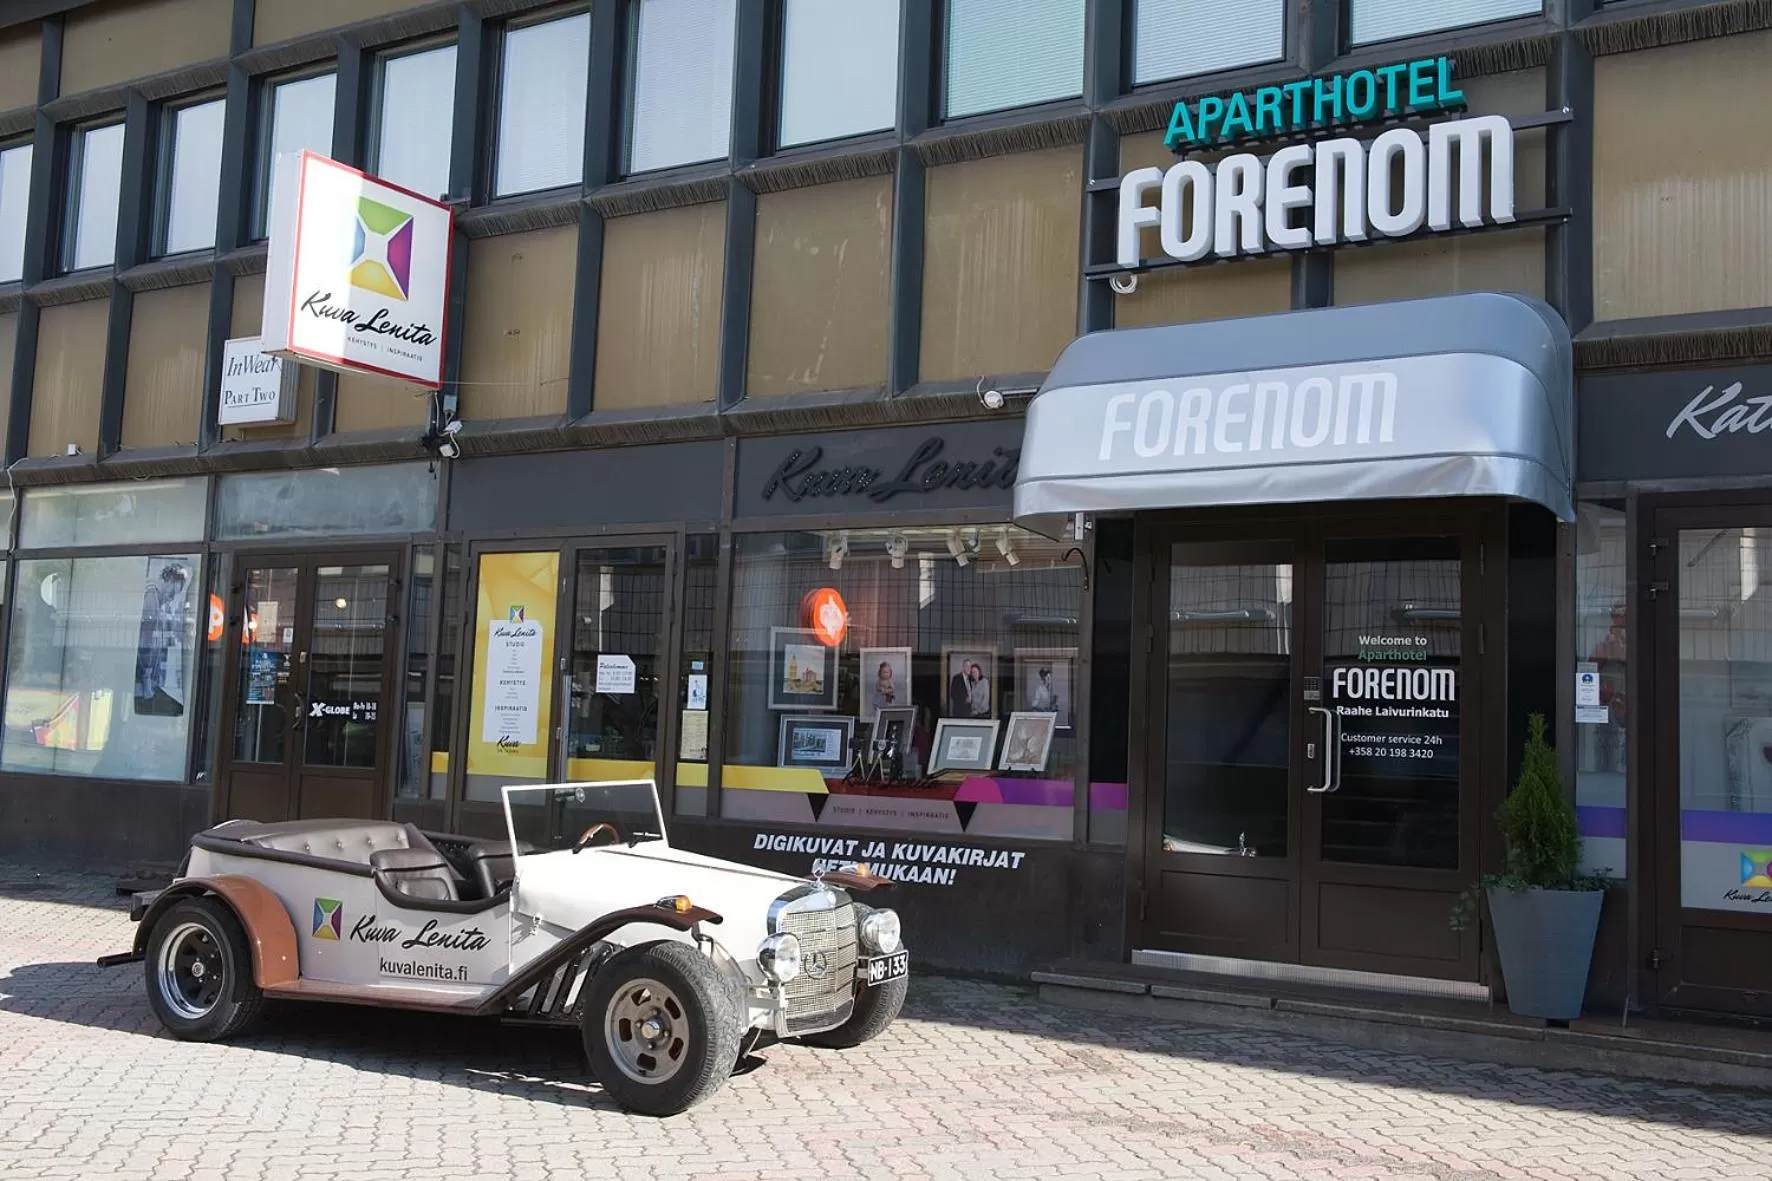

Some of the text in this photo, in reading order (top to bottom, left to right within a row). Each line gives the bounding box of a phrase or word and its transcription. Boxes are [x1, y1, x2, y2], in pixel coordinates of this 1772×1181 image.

[1164, 56, 1466, 148] APARTHOTEL
[1117, 115, 1515, 268] FORENOM
[300, 290, 438, 346] Kuva Lenita
[227, 354, 279, 376] InWear
[1099, 372, 1398, 460] FORENOM
[1666, 381, 1772, 439] Kat
[761, 436, 1022, 503] Kuva Lenit
[1358, 635, 1428, 646] Welcome to
[1358, 649, 1427, 662] Aparthotel
[1332, 667, 1456, 701] FORENOM
[309, 702, 351, 717] X-GLOBE
[1336, 705, 1449, 718] Raahe Laivurinkatu
[1341, 733, 1443, 746] Customer service 24h
[1349, 746, 1434, 759] +358 20 198 3420
[753, 833, 1026, 870] DIGIKUVAT JA KUVAKIRJAT
[1722, 889, 1751, 901] Kuva
[350, 914, 491, 951] Kuva Lenita
[379, 957, 469, 981] kuvalenita.fi
[870, 954, 906, 982] NB-133
